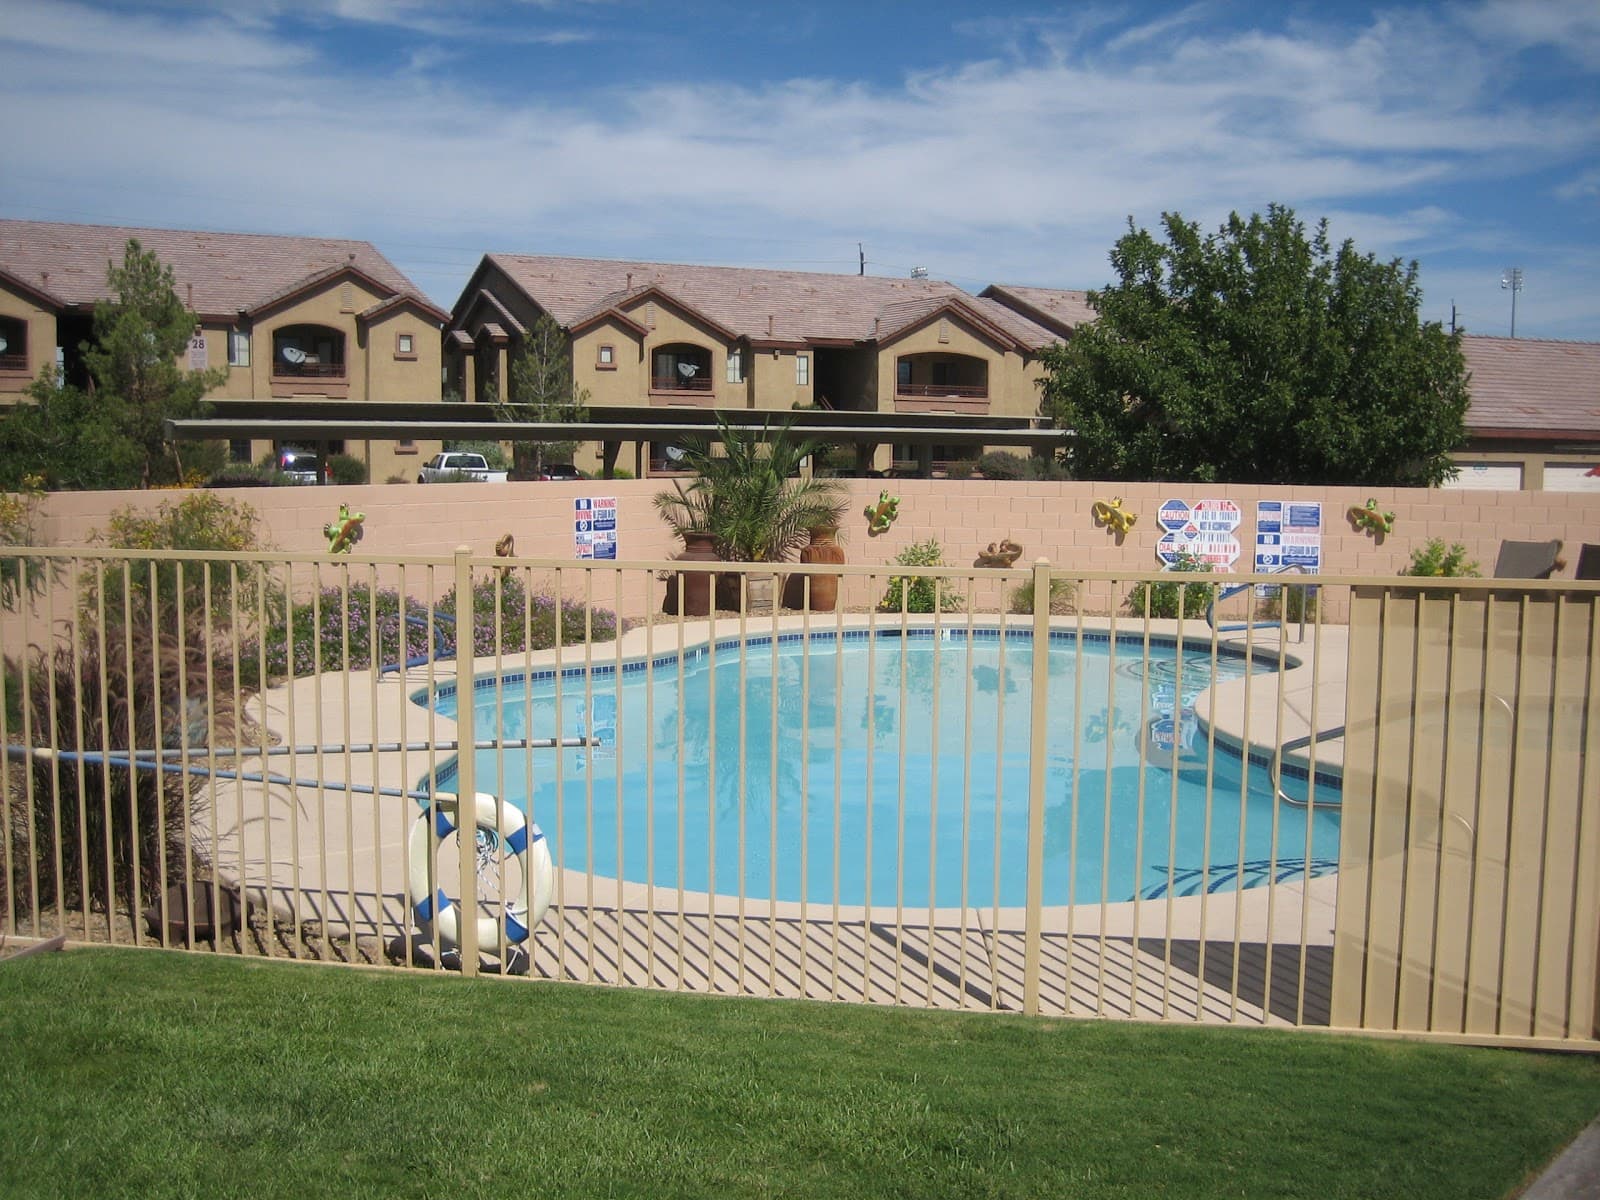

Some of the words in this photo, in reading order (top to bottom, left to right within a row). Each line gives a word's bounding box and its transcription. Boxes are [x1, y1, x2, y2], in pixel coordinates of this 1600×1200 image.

[192, 339, 205, 349] 28
[1160, 511, 1189, 520] CAUTION
[1264, 536, 1274, 544] NO
[1159, 543, 1173, 552] DIAL
